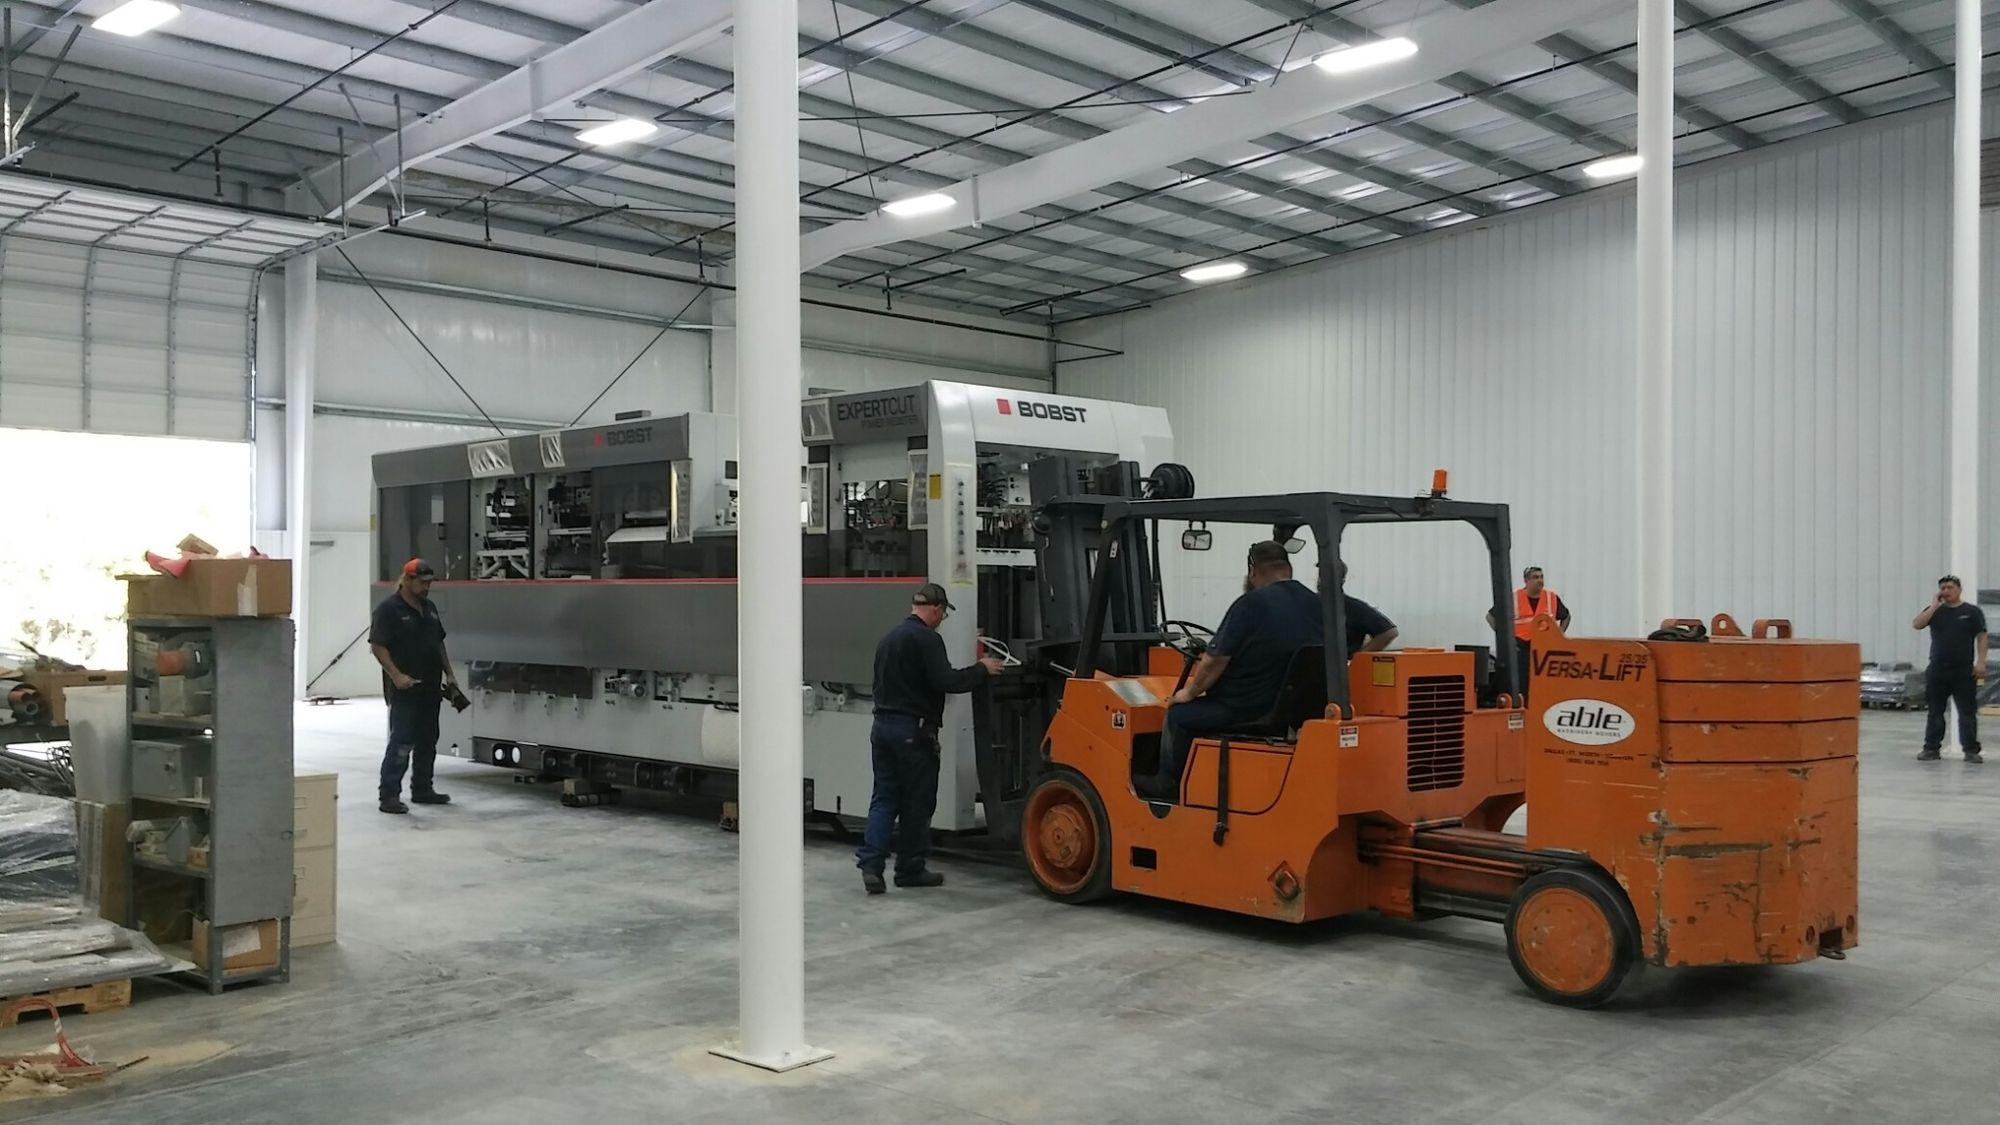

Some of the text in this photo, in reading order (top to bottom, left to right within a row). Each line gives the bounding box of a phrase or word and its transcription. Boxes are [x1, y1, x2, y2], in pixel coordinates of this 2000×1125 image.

[837, 395, 915, 420] EXPERTCUT
[1017, 401, 1087, 423] BOBST
[607, 427, 653, 446] BOBST
[1532, 649, 1646, 682] VERSA-LIFT
[1557, 706, 1622, 730] able
